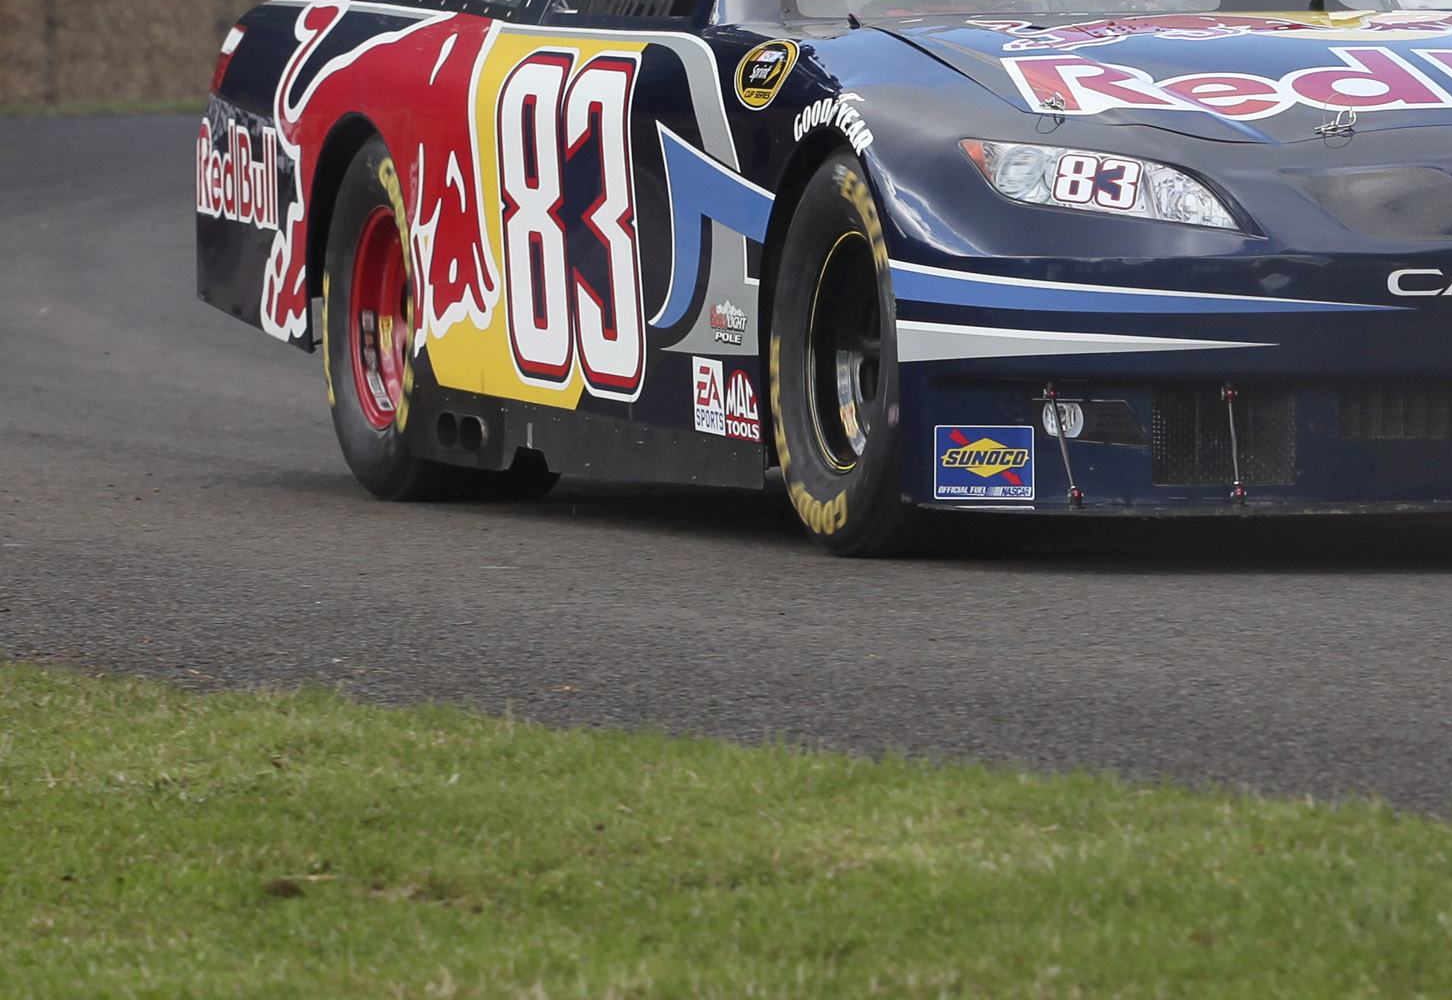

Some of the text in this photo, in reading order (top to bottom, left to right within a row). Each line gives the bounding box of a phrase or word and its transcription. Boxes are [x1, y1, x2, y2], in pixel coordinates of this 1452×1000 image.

[794, 97, 874, 157] GOODYEAR
[1050, 153, 1144, 211] 83
[495, 45, 646, 403] 83
[714, 330, 742, 345] POLE
[697, 365, 722, 409] EA
[726, 373, 759, 421] MAC
[696, 408, 725, 432] SPORTS
[727, 419, 761, 440] TOOLS
[945, 450, 1027, 466] SUNOCO
[938, 486, 1032, 496] OFFICIAL FUEL NASCAR
